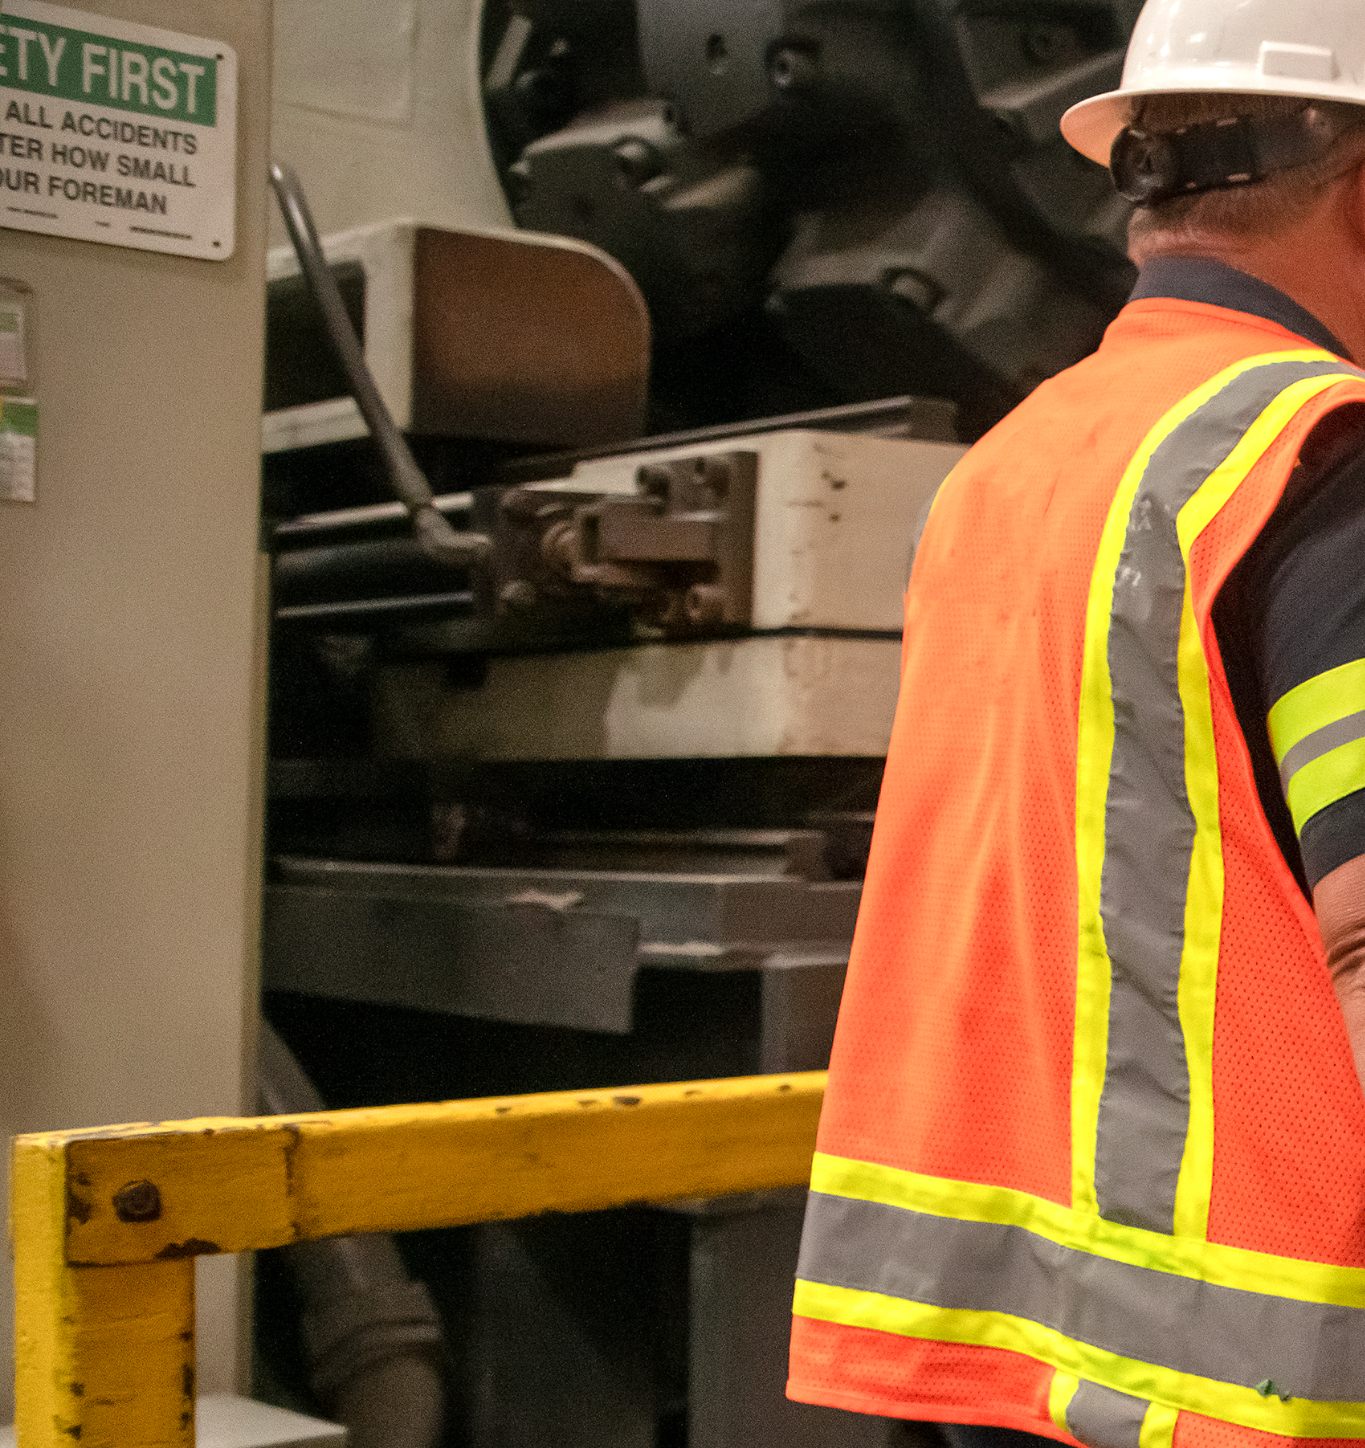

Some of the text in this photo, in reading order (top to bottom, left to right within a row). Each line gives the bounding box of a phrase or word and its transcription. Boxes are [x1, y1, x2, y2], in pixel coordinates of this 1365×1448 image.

[82, 43, 205, 114] FIRST
[5, 100, 197, 155] ALL ACCIDENTS
[52, 142, 110, 172] HOW
[117, 154, 197, 188] SMALL
[0, 167, 40, 195] UR
[48, 176, 168, 215] FOREMAN
